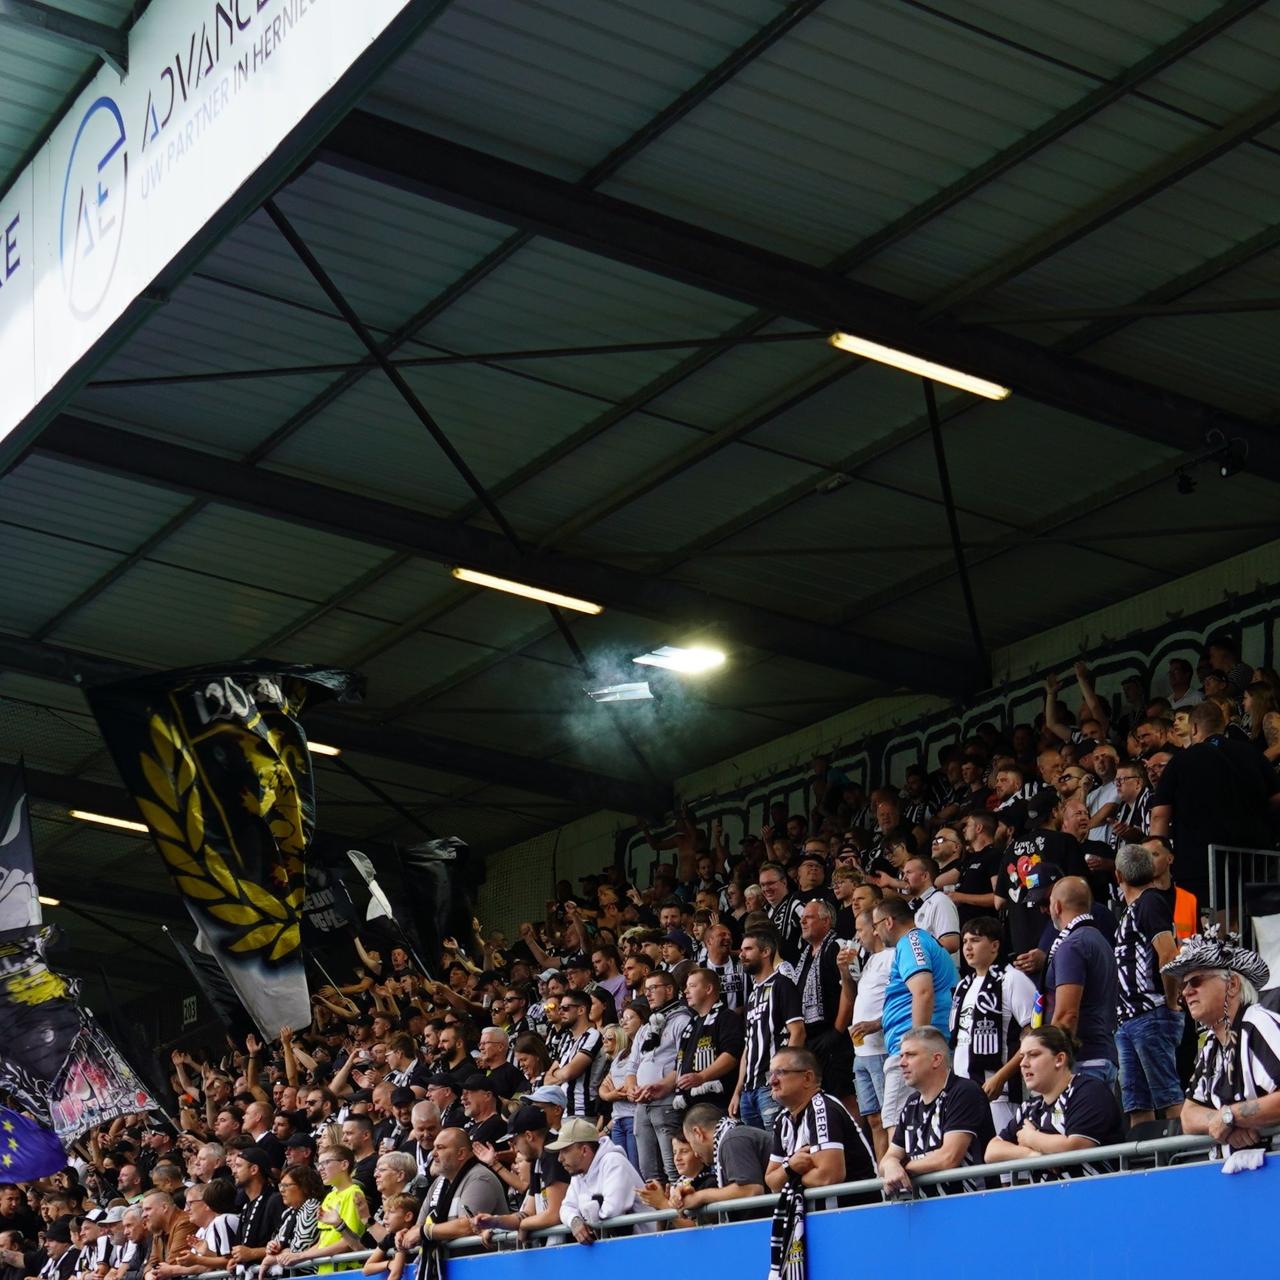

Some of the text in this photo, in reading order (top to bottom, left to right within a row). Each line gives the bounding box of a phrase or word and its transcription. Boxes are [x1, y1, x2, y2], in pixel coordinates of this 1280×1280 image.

[142, 0, 271, 152] ADVANC
[234, 52, 249, 95] IN
[253, 0, 317, 73] HERNIE
